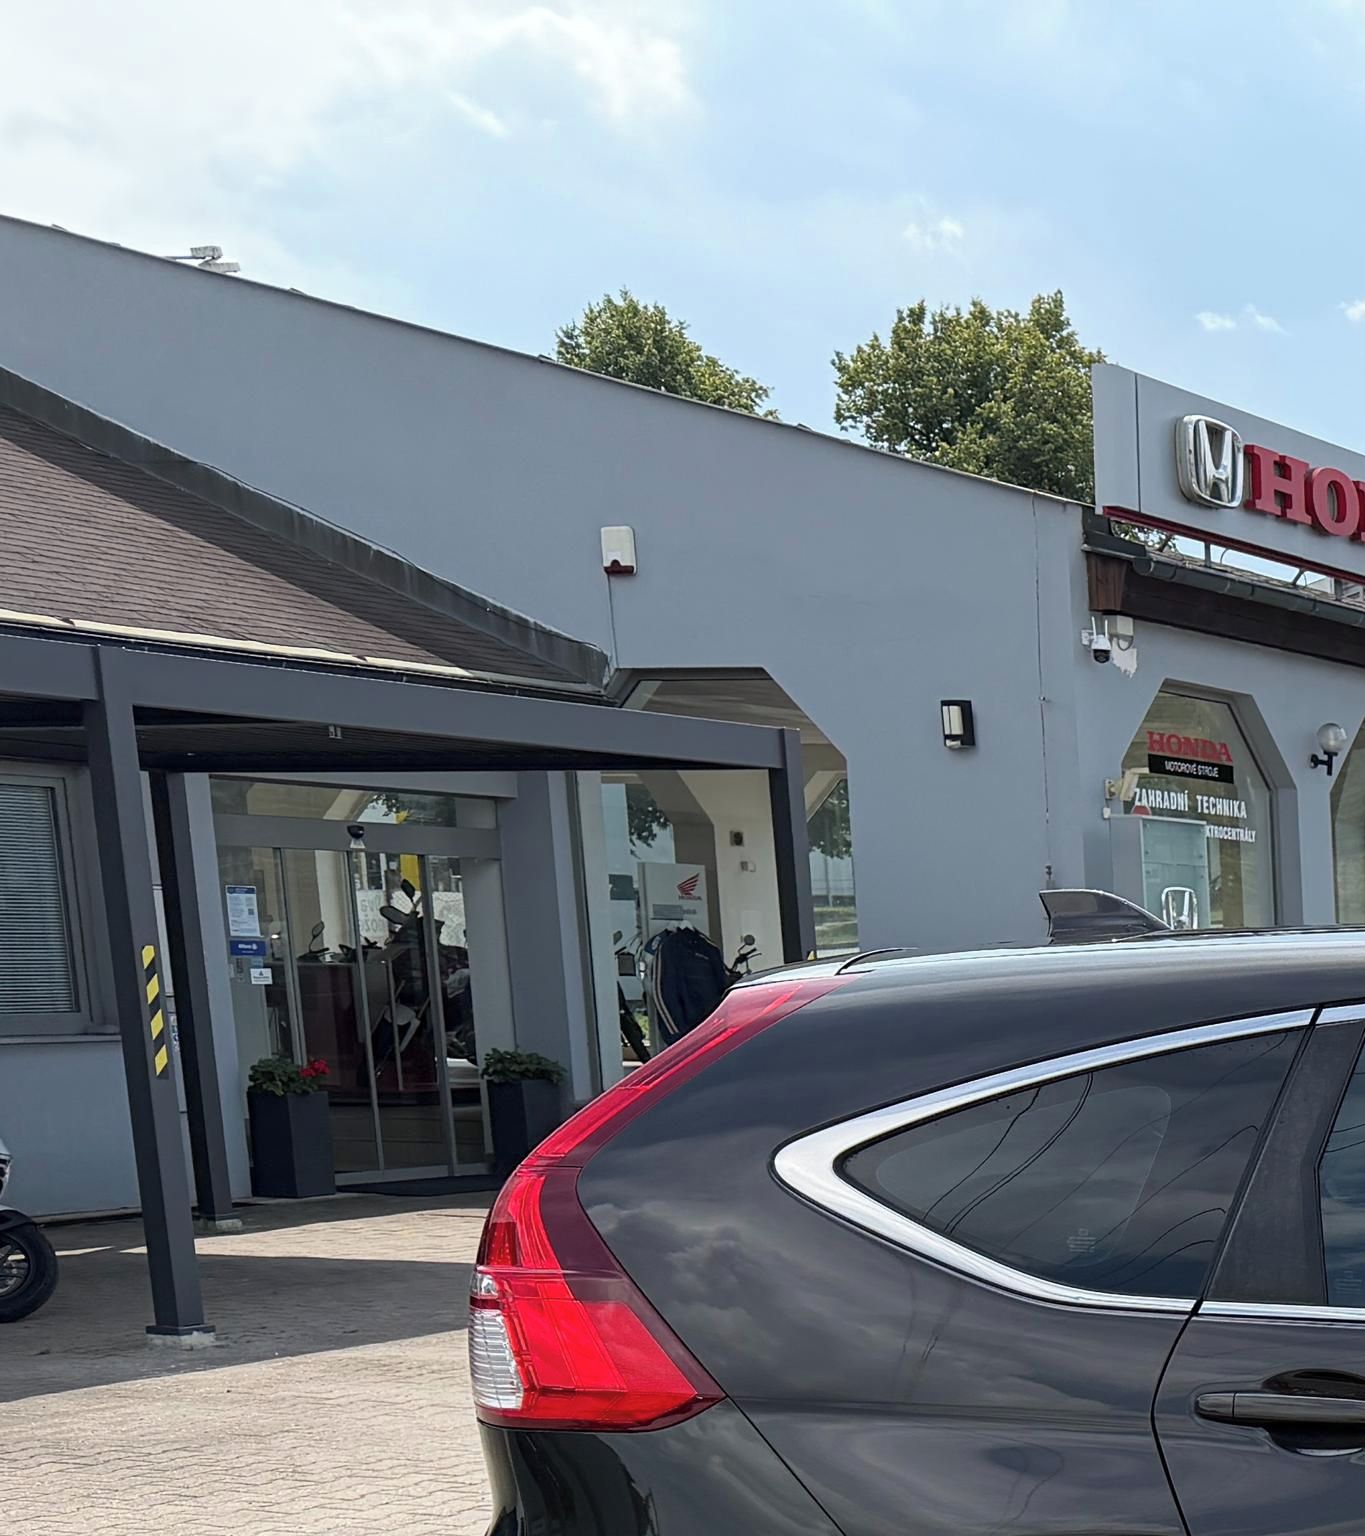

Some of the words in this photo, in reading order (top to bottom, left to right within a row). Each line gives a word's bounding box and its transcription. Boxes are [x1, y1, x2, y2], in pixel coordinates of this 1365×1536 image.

[1146, 731, 1232, 763] HONDA
[1164, 760, 1196, 775] MOTOROVÉ
[1197, 764, 1220, 778] STROJE
[1134, 788, 1189, 812] ZAHRADNÍ
[1196, 795, 1247, 819] TECHNIKA
[1205, 825, 1257, 843] KTROCENTRÁLY
